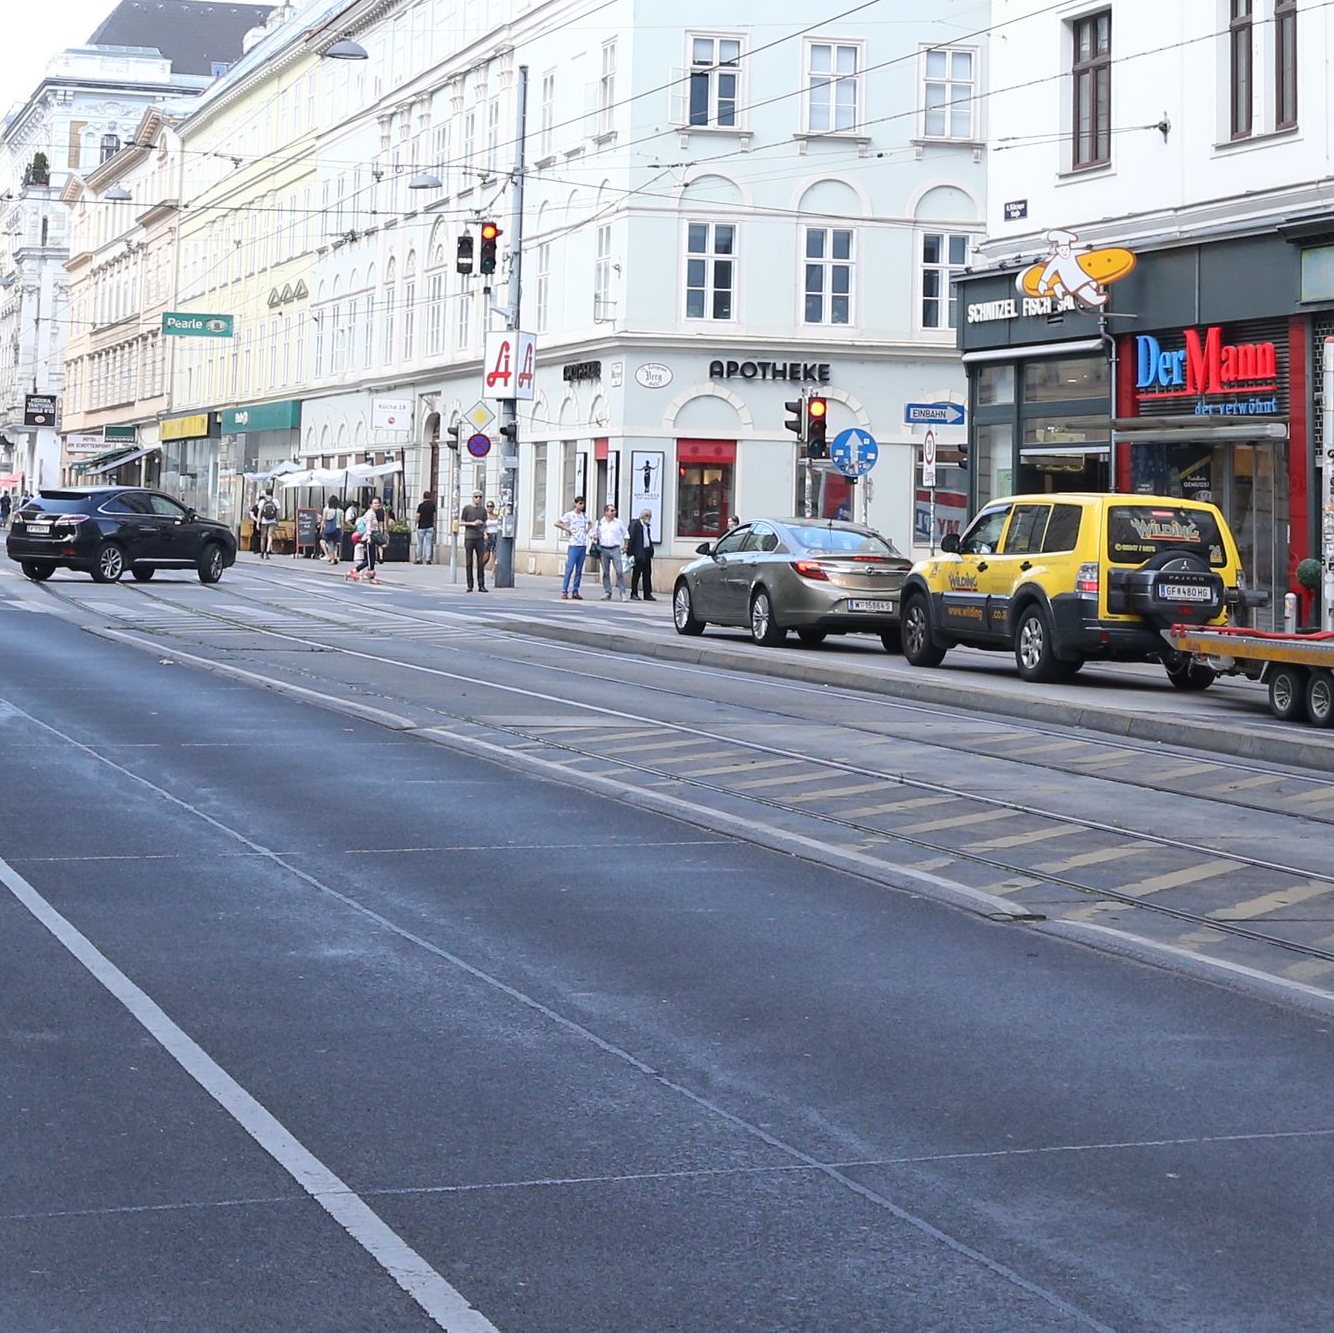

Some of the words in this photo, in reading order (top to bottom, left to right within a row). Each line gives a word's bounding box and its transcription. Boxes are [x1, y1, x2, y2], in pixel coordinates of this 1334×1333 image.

[967, 299, 1019, 324] SCHNITZEL
[1022, 296, 1053, 317] FISCH
[167, 317, 203, 330] Pearle
[1135, 335, 1186, 388] Der
[1183, 326, 1278, 395] Mann
[709, 360, 831, 382] APOTHEKE
[912, 409, 947, 419] EINBAHN
[1194, 400, 1213, 416] der
[1218, 396, 1280, 415] verwöhnt
[1129, 518, 1201, 539] WILDING
[1166, 586, 1177, 595] GF
[1181, 586, 1197, 596] 480
[1197, 588, 1208, 597] HG
